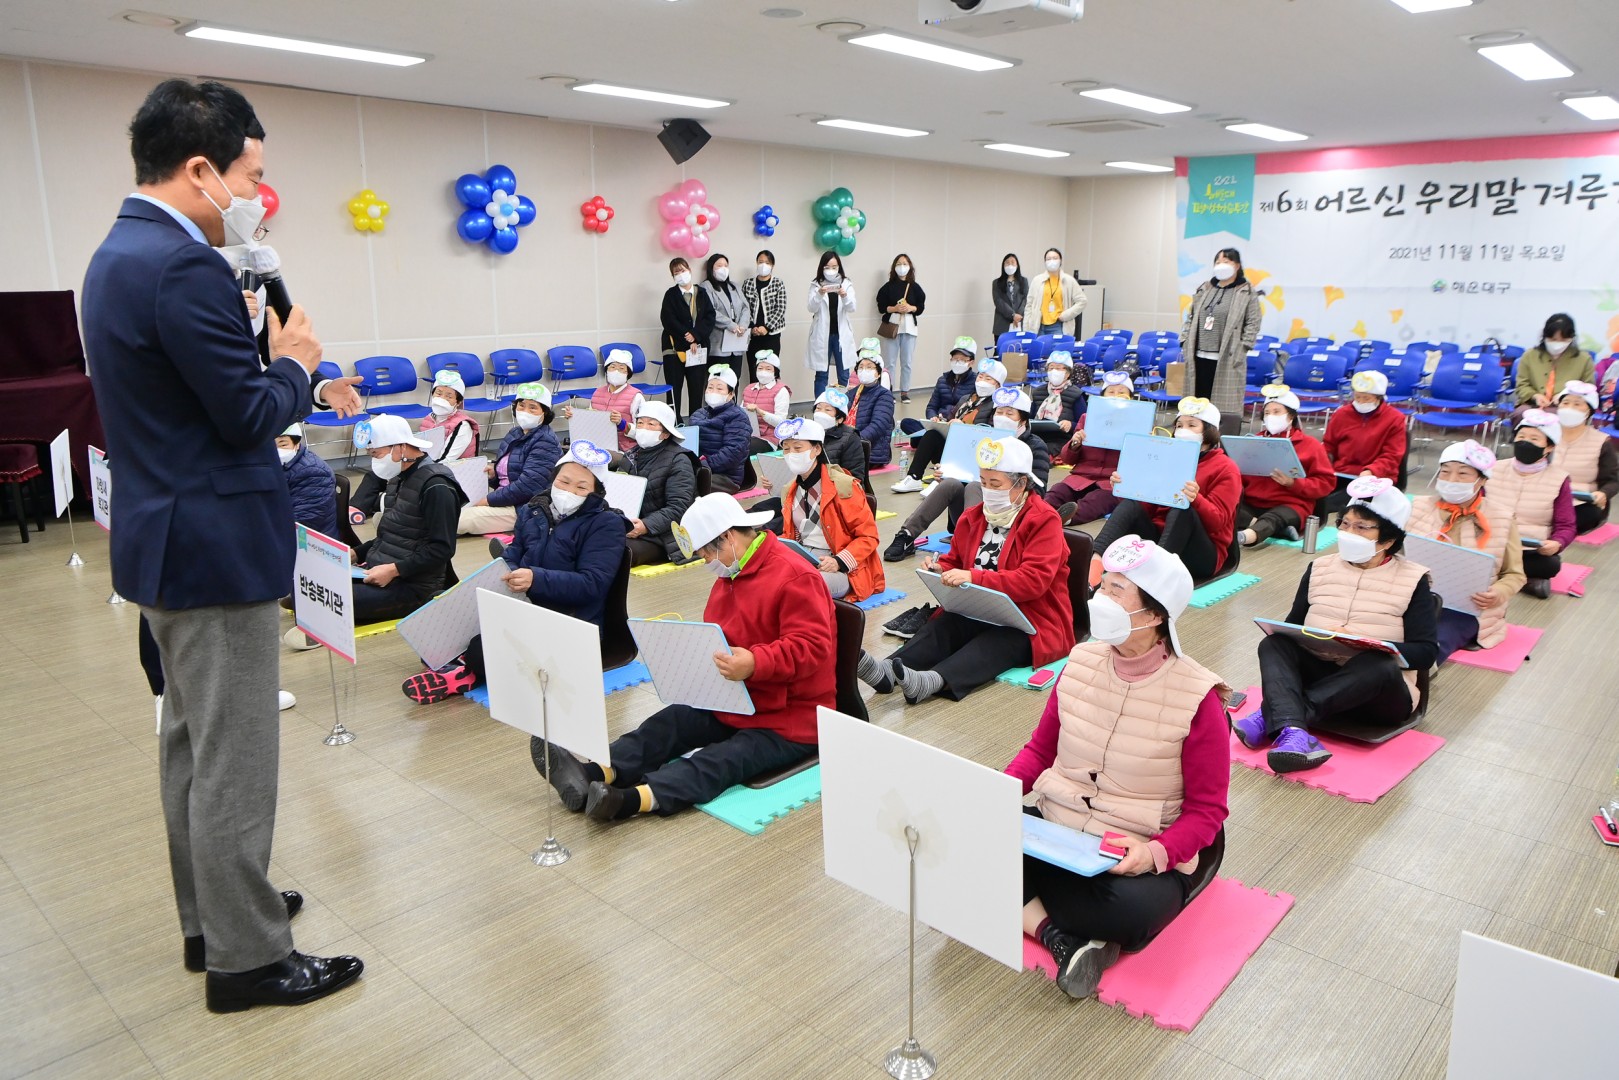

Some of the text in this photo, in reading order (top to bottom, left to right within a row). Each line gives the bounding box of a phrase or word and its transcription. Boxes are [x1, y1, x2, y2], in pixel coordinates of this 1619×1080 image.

[1259, 173, 1619, 217] 제6회 어르신 우리말 겨루
[1388, 244, 1566, 261] 2021년 11월 11일 목요일
[1452, 281, 1512, 295] 해운대구
[299, 573, 344, 617] 반송복지관
